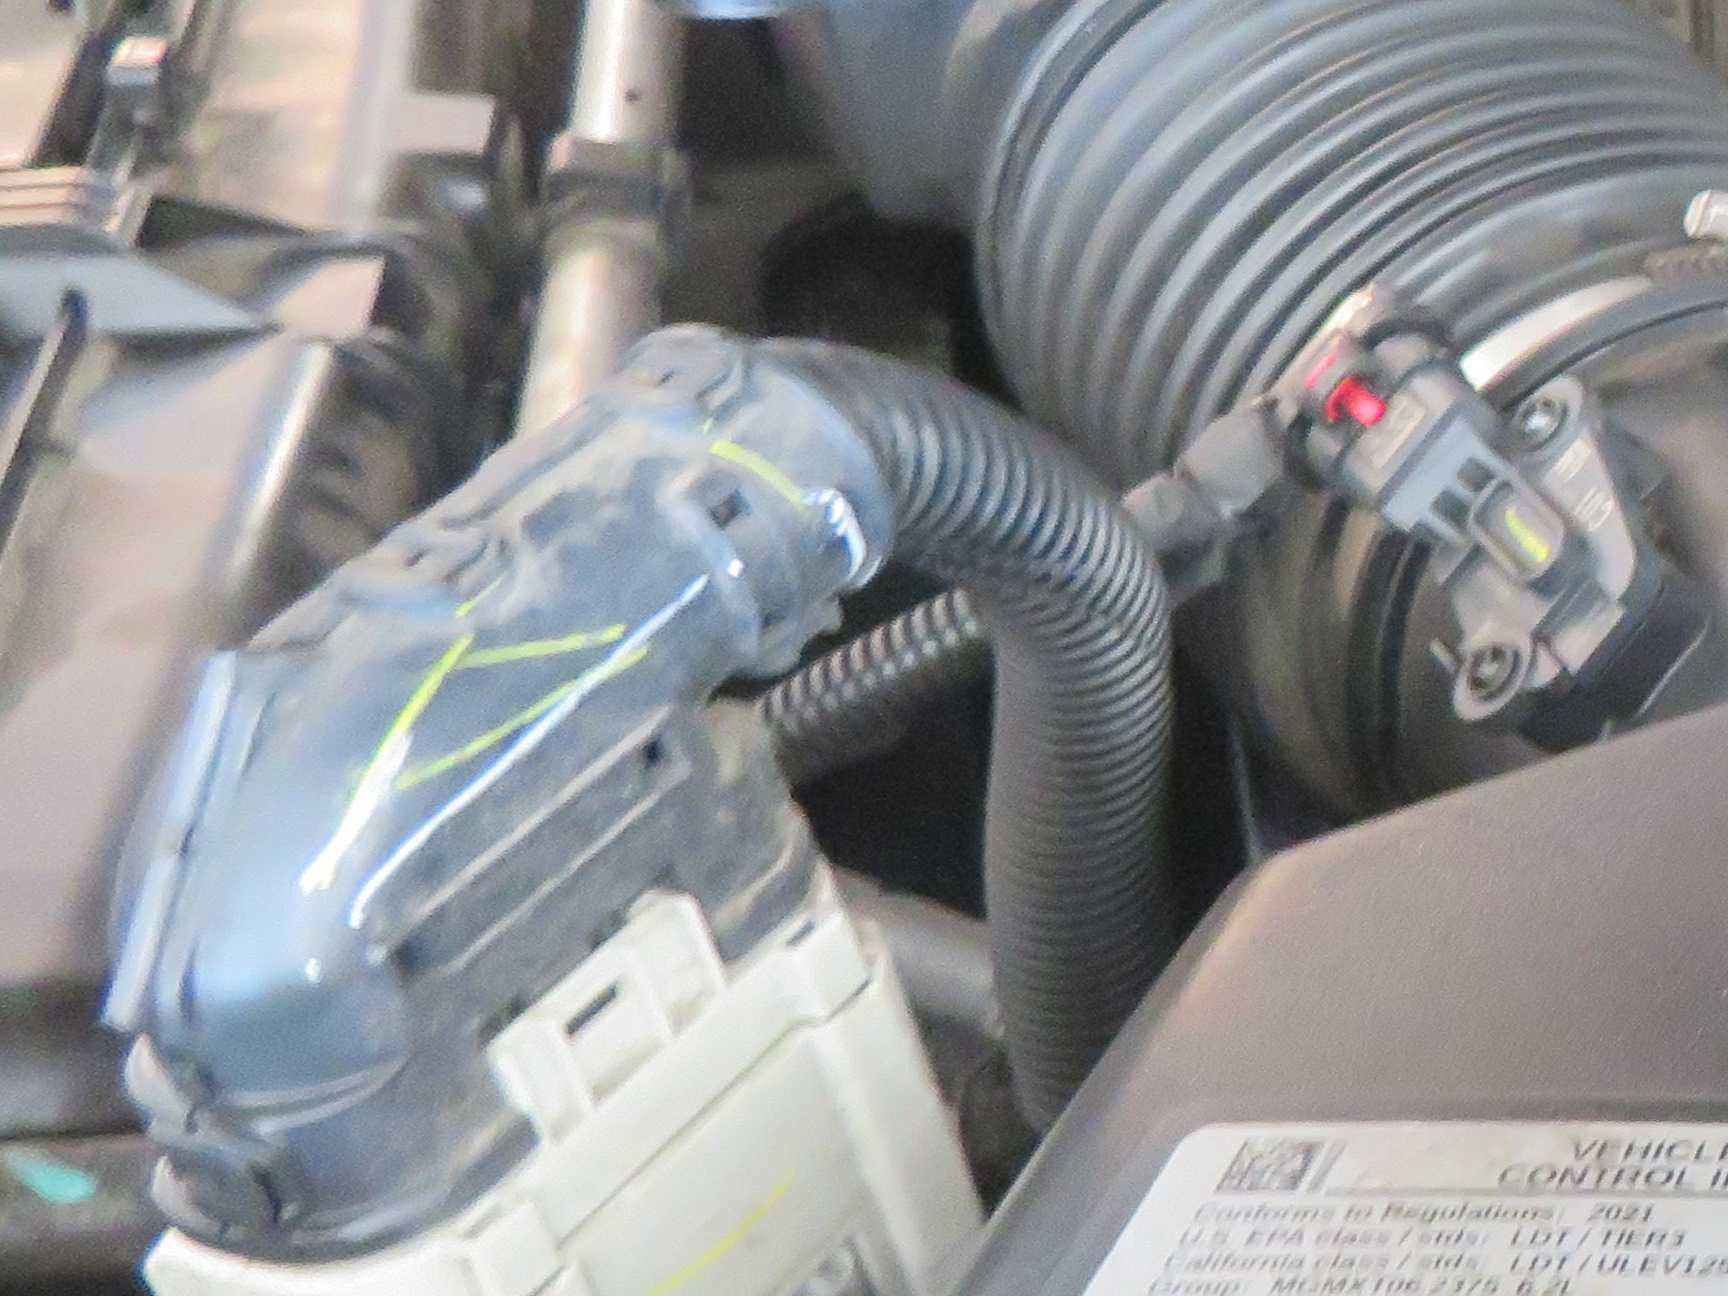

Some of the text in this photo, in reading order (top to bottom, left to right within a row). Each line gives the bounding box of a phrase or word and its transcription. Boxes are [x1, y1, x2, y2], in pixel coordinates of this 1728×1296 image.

[1498, 1163, 1690, 1191] CONTROL
[1194, 1203, 1335, 1222] Conforms
[1344, 1203, 1373, 1221] to
[1587, 1204, 1654, 1222] 2021
[1244, 1228, 1305, 1247] EPA
[1314, 1226, 1391, 1247] class
[1509, 1228, 1574, 1248] LDT
[1163, 1252, 1305, 1272] California
[1314, 1250, 1390, 1271] class
[1509, 1253, 1575, 1273] LDT
